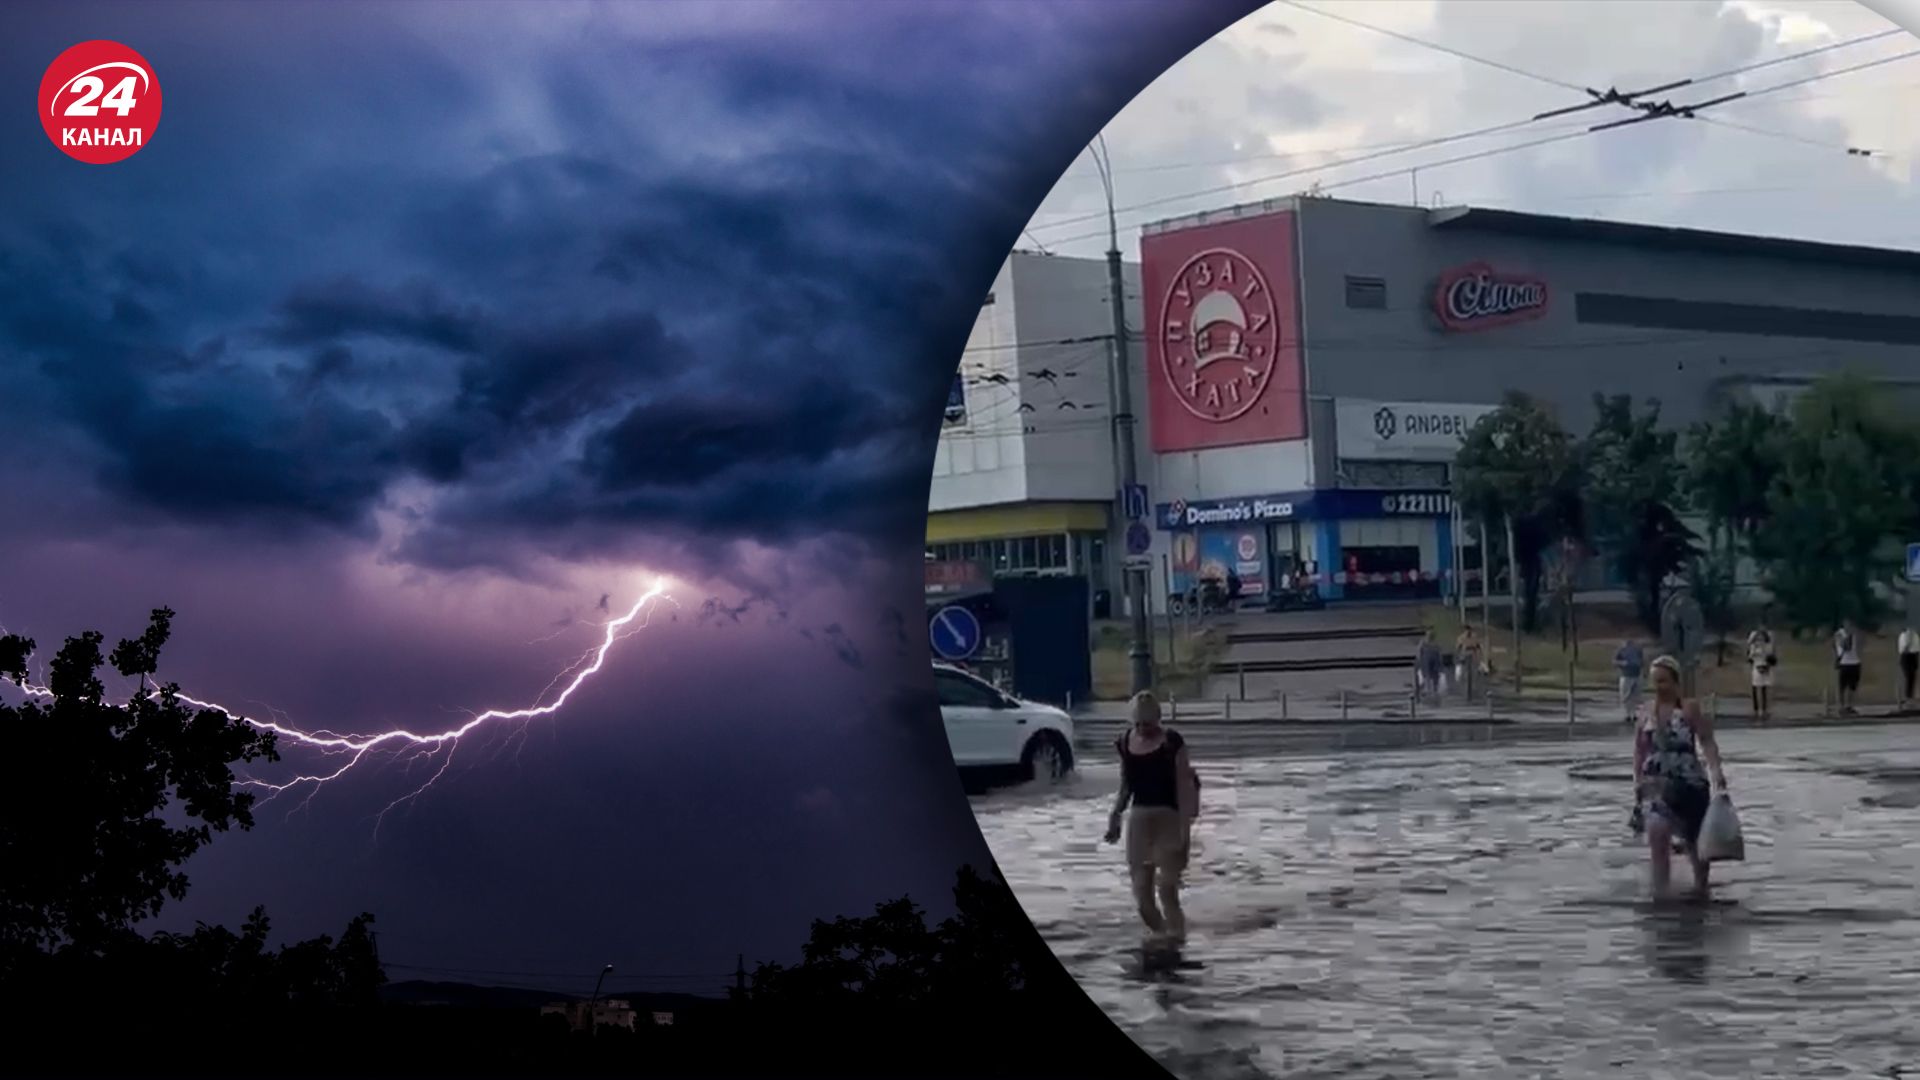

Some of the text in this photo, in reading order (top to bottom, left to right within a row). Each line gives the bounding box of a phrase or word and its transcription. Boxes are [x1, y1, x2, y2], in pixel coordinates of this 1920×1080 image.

[1167, 260, 1271, 341] ПУЗАТА
[1186, 365, 1264, 409] ХАТА
[1187, 499, 1293, 525] Domino's Pizza
